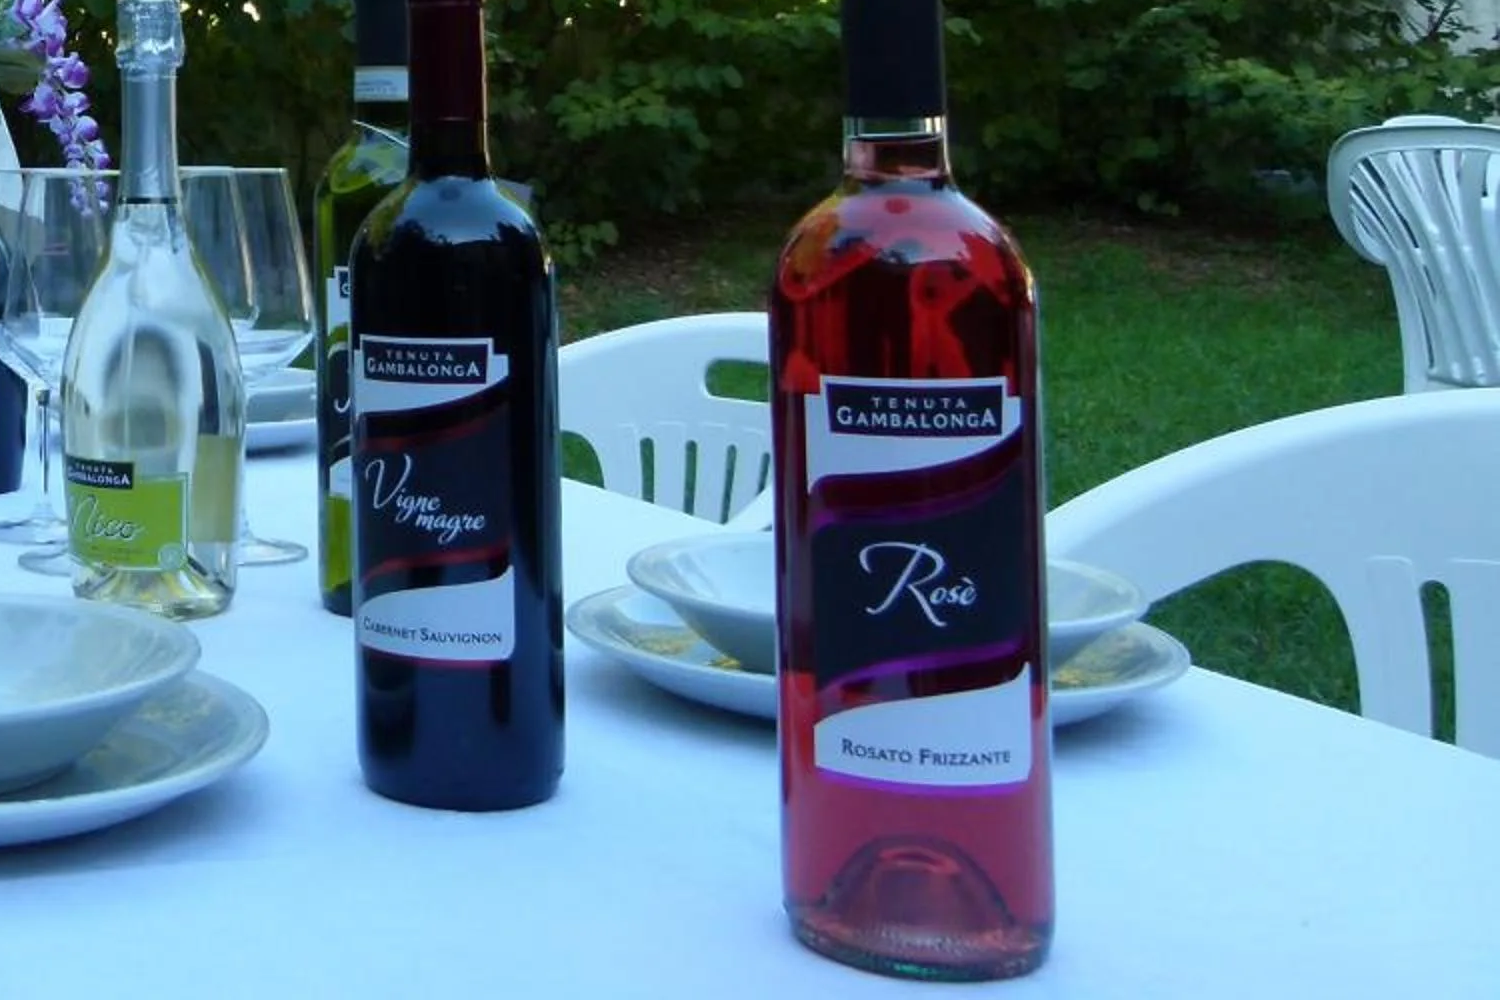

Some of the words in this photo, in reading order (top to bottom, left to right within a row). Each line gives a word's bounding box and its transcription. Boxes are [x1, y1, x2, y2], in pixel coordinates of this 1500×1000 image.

[366, 357, 481, 378] GAMBALONGA
[385, 350, 454, 361] TENUTA
[870, 397, 968, 409] TENUTA
[835, 406, 998, 429] GAMBALONGA
[364, 453, 441, 523] Vigne
[415, 513, 486, 545] magre
[858, 541, 978, 627] Rosè
[363, 615, 417, 642] CABERNET
[419, 627, 502, 645] SAUVIGNON
[841, 738, 913, 763] ROSATO
[918, 748, 1011, 766] FRIZZANTE
